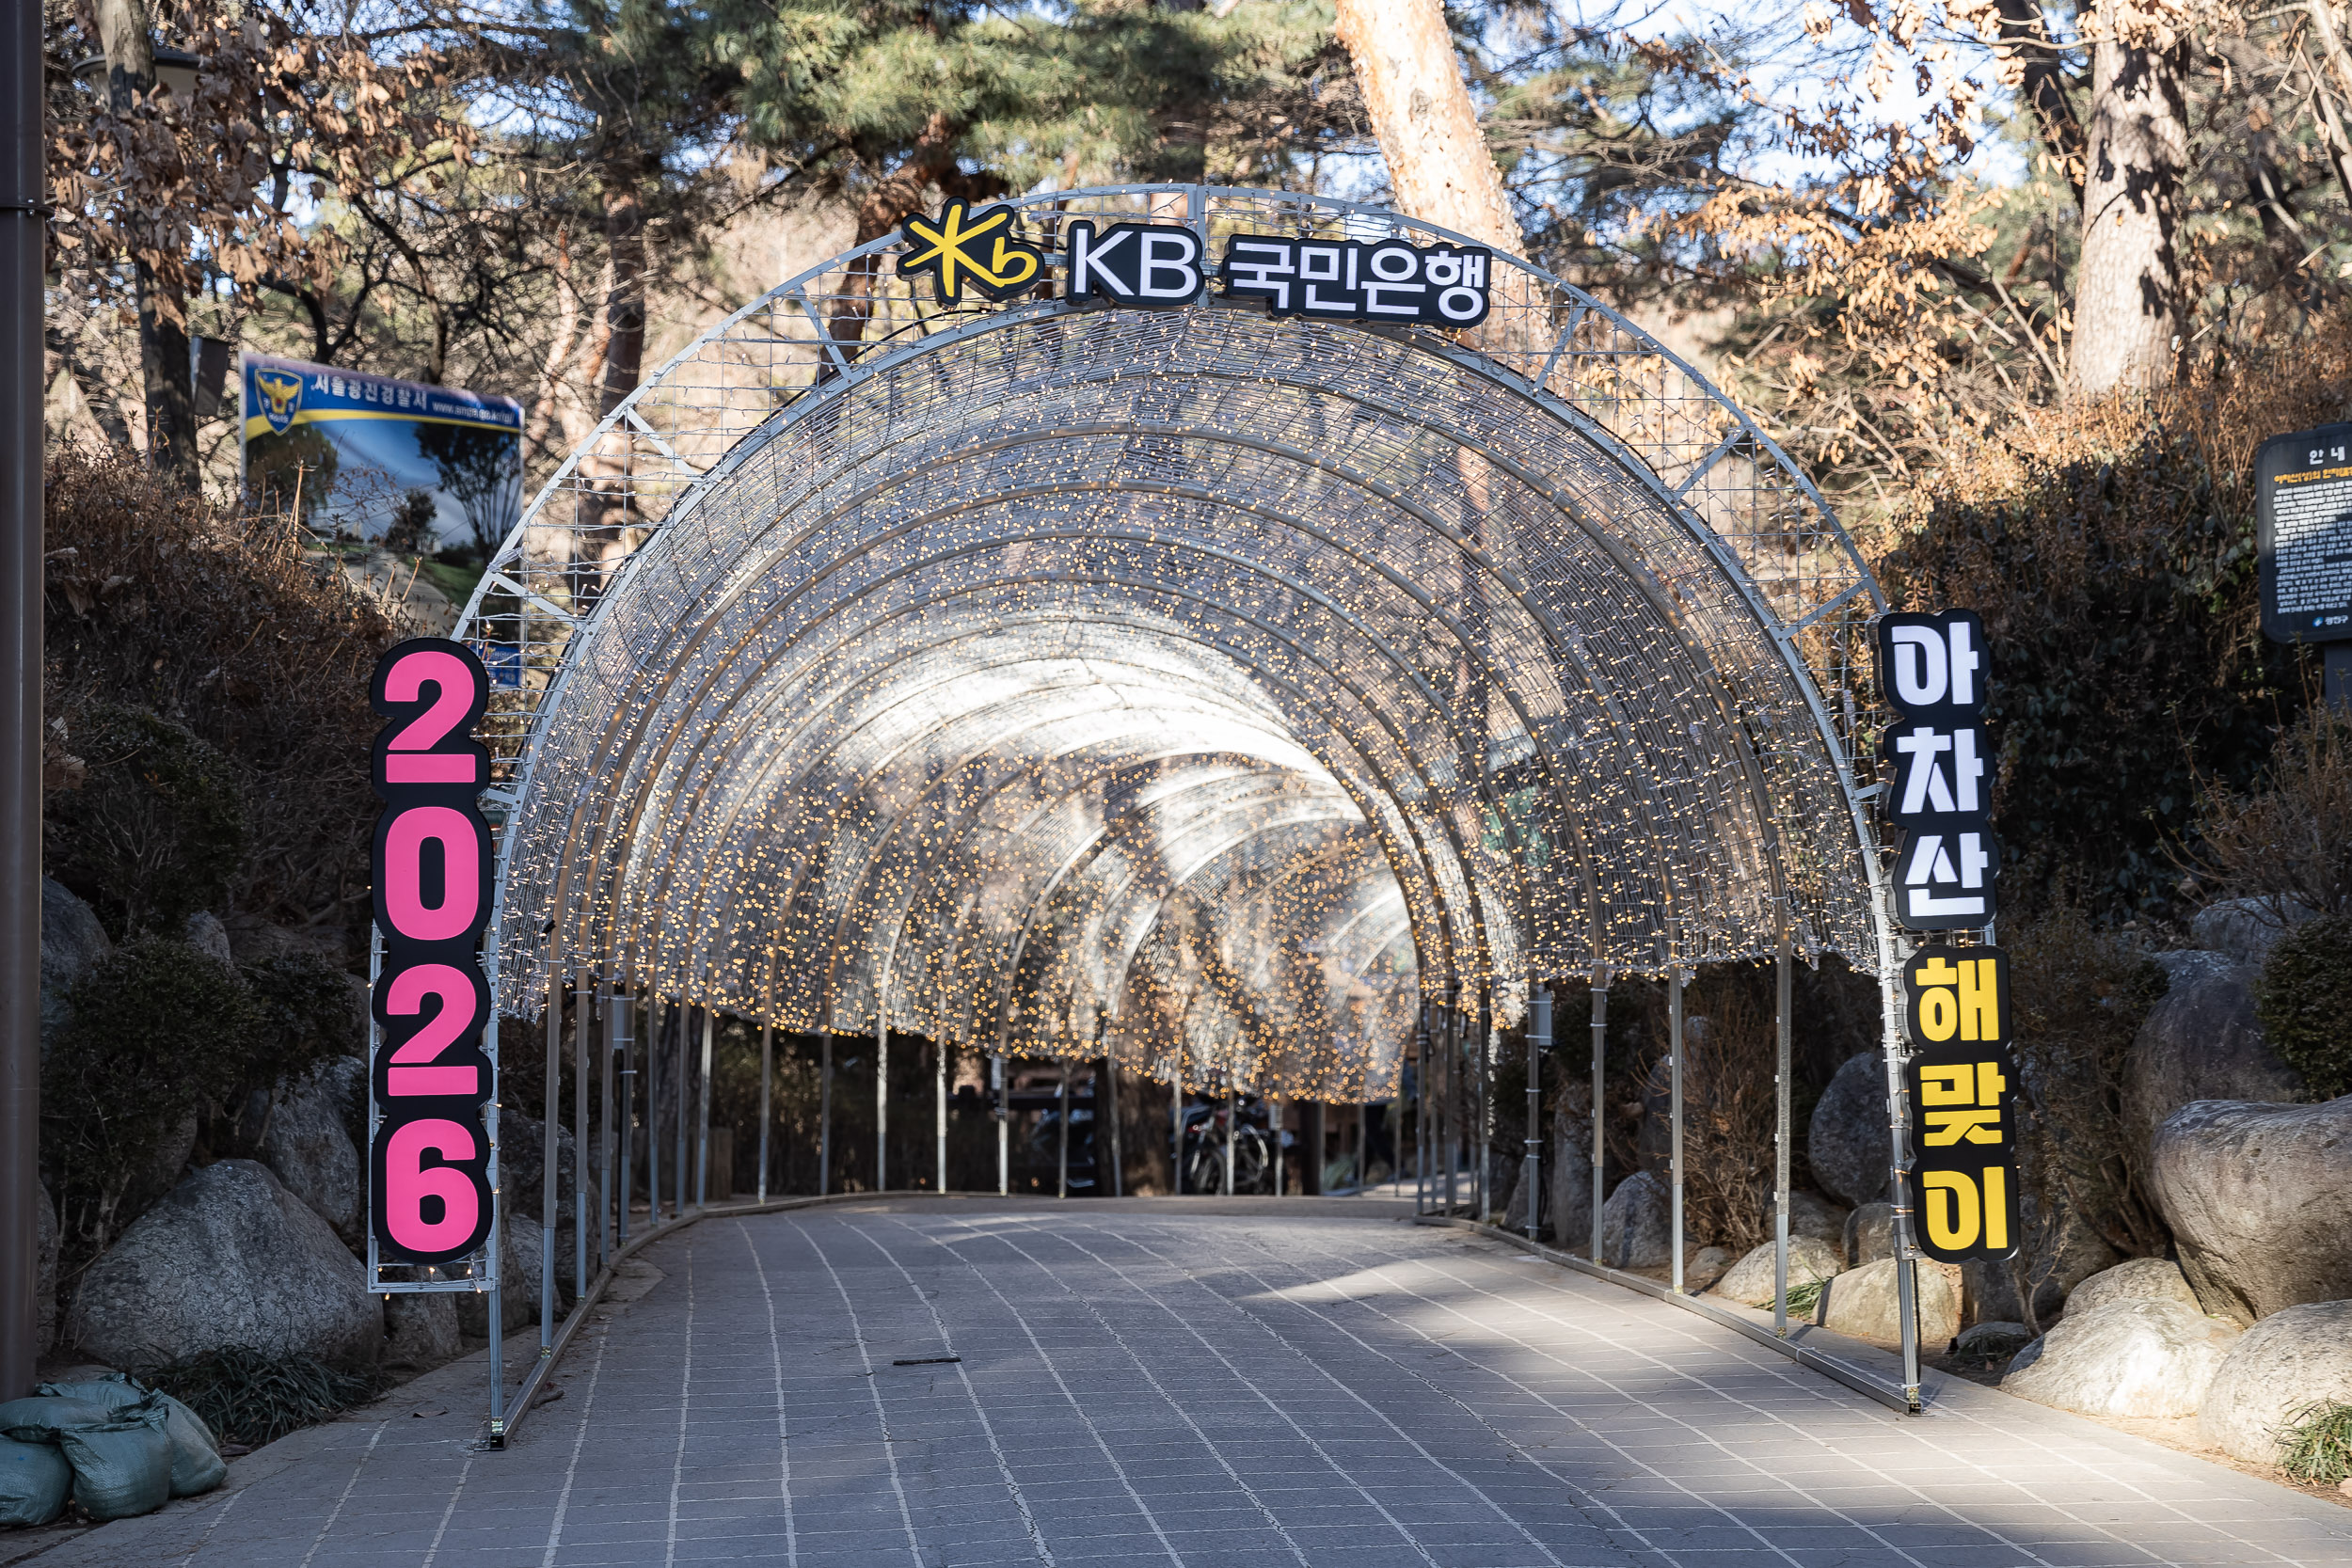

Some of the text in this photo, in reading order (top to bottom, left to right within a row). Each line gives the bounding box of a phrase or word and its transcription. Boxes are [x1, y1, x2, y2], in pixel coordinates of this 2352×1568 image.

[310, 373, 427, 411] 서울광진경찰서
[1074, 228, 1485, 323] KB 국민은행
[384, 650, 479, 1253] 2026
[1891, 621, 2007, 1251] 아차산 해맞이
